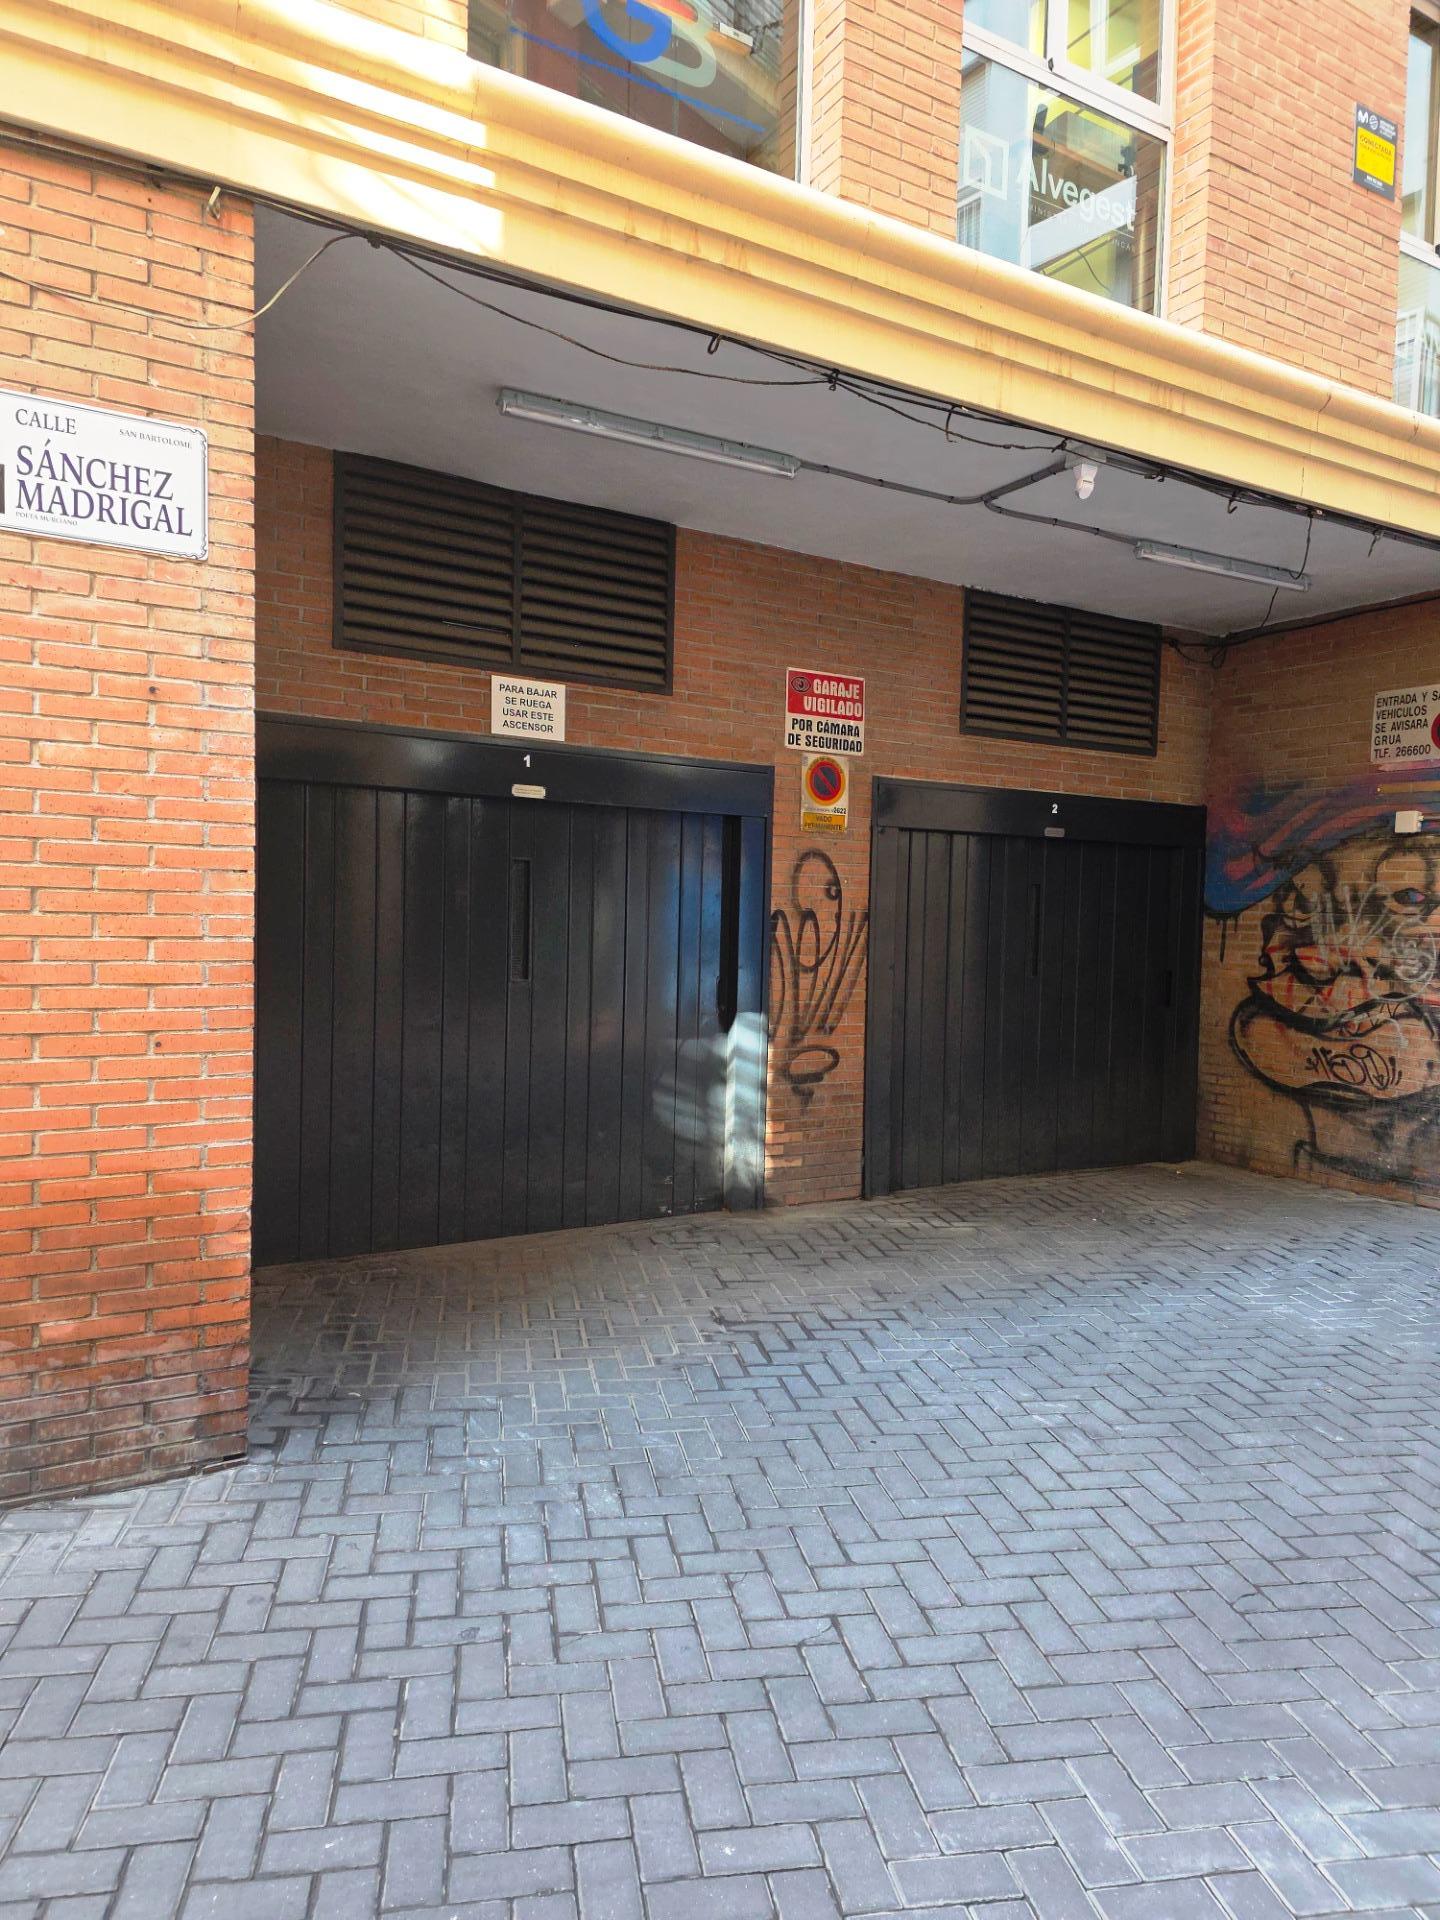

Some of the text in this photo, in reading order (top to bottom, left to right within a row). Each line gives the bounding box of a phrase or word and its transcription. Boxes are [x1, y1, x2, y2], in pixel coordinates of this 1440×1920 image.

[1016, 156, 1136, 232] Alvegest
[15, 408, 77, 435] CALLE
[119, 428, 137, 438] SAN
[16, 438, 174, 500] SÁNCHEZ
[15, 479, 193, 537] MADRIGAL
[499, 683, 558, 699] PARA BAJAR
[813, 679, 860, 699] GARAJE
[505, 696, 552, 710] SE RUEGA
[803, 696, 862, 718] VIGILADO
[1376, 693, 1417, 708] ENTRADA
[1422, 691, 1428, 702] Y
[502, 708, 554, 722] USAR ESTE
[1376, 705, 1428, 720] VEHICULOS
[502, 720, 554, 733] ASCENSOR
[791, 718, 860, 737] POR CÁMARA
[1375, 718, 1429, 733] SE AVISARA
[788, 733, 862, 753] DE SEGURIDAD
[1374, 734, 1402, 746] GRUA
[1374, 744, 1431, 759] TLF. 266600
[523, 754, 531, 768] 1
[1051, 803, 1059, 814] 2
[815, 815, 833, 823] VADO
